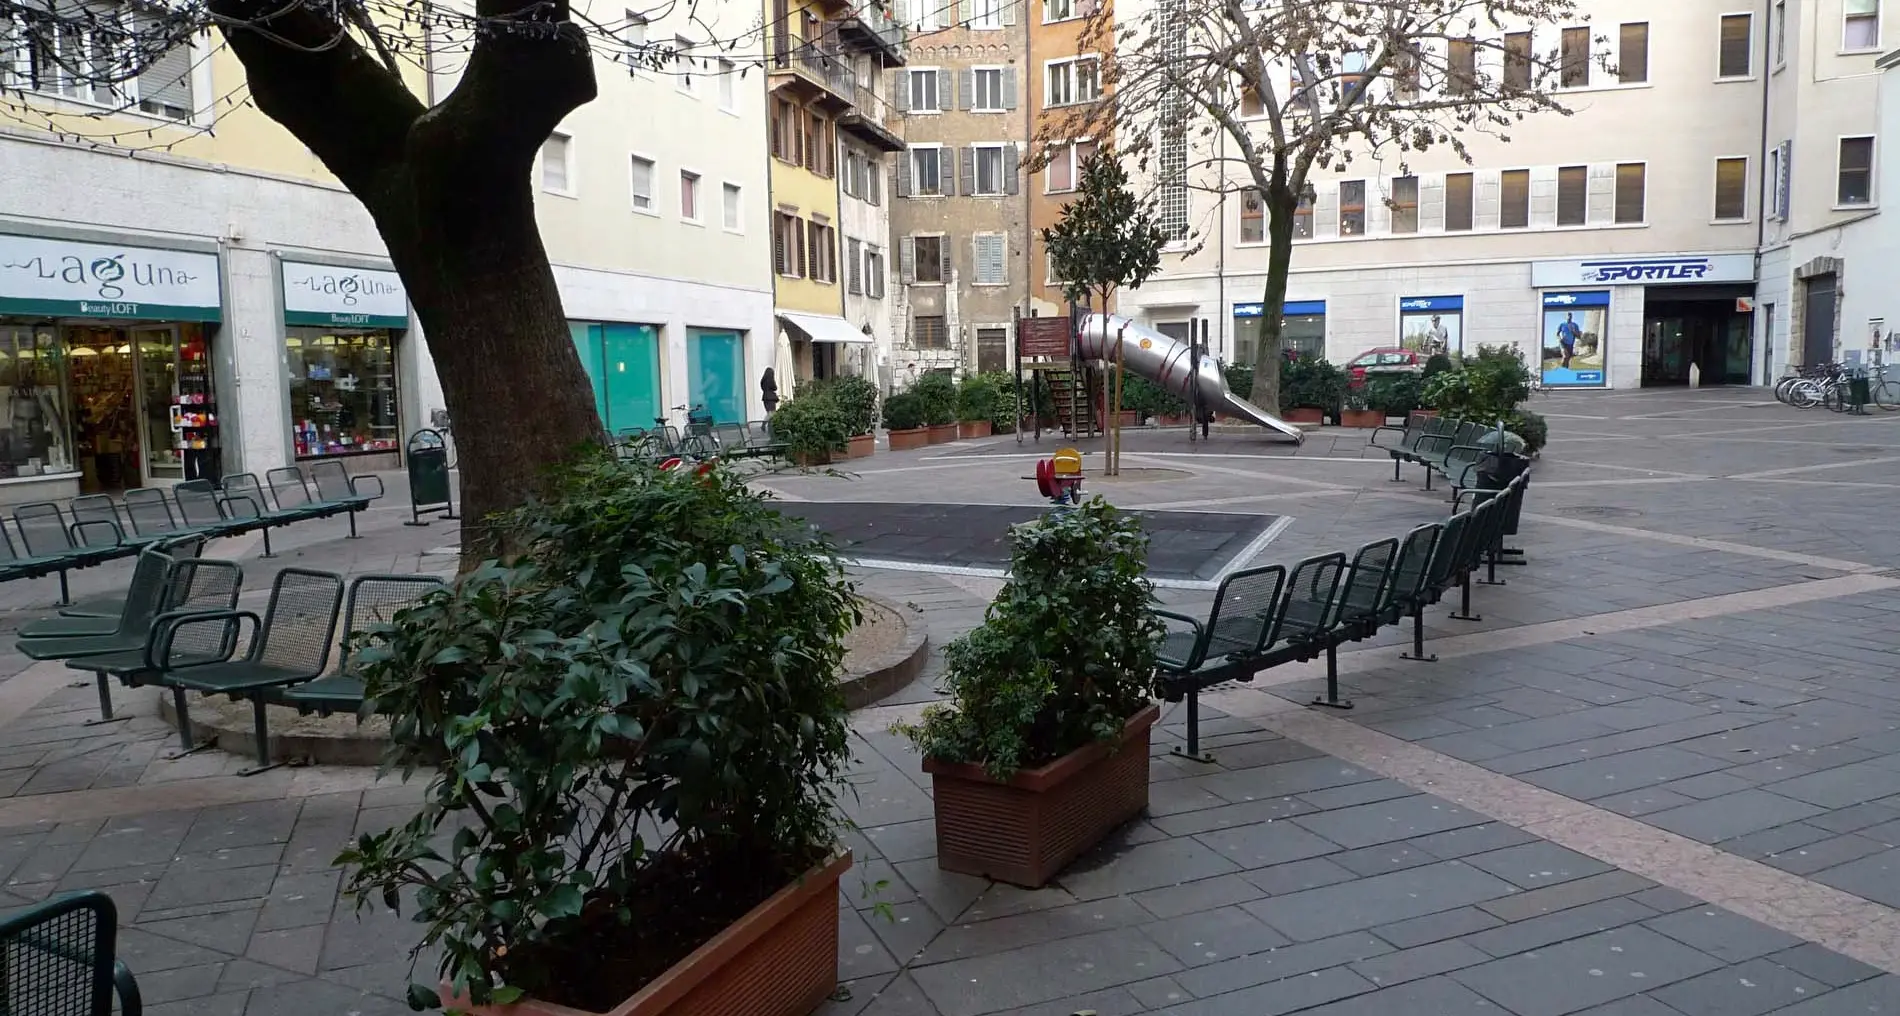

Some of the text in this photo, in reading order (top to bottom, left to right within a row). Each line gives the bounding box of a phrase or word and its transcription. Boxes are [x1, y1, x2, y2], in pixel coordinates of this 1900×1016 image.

[3, 254, 198, 299] Laguna
[1596, 264, 1707, 281] SPORTLER
[293, 274, 398, 306] Laguna
[111, 303, 138, 315] LOFT
